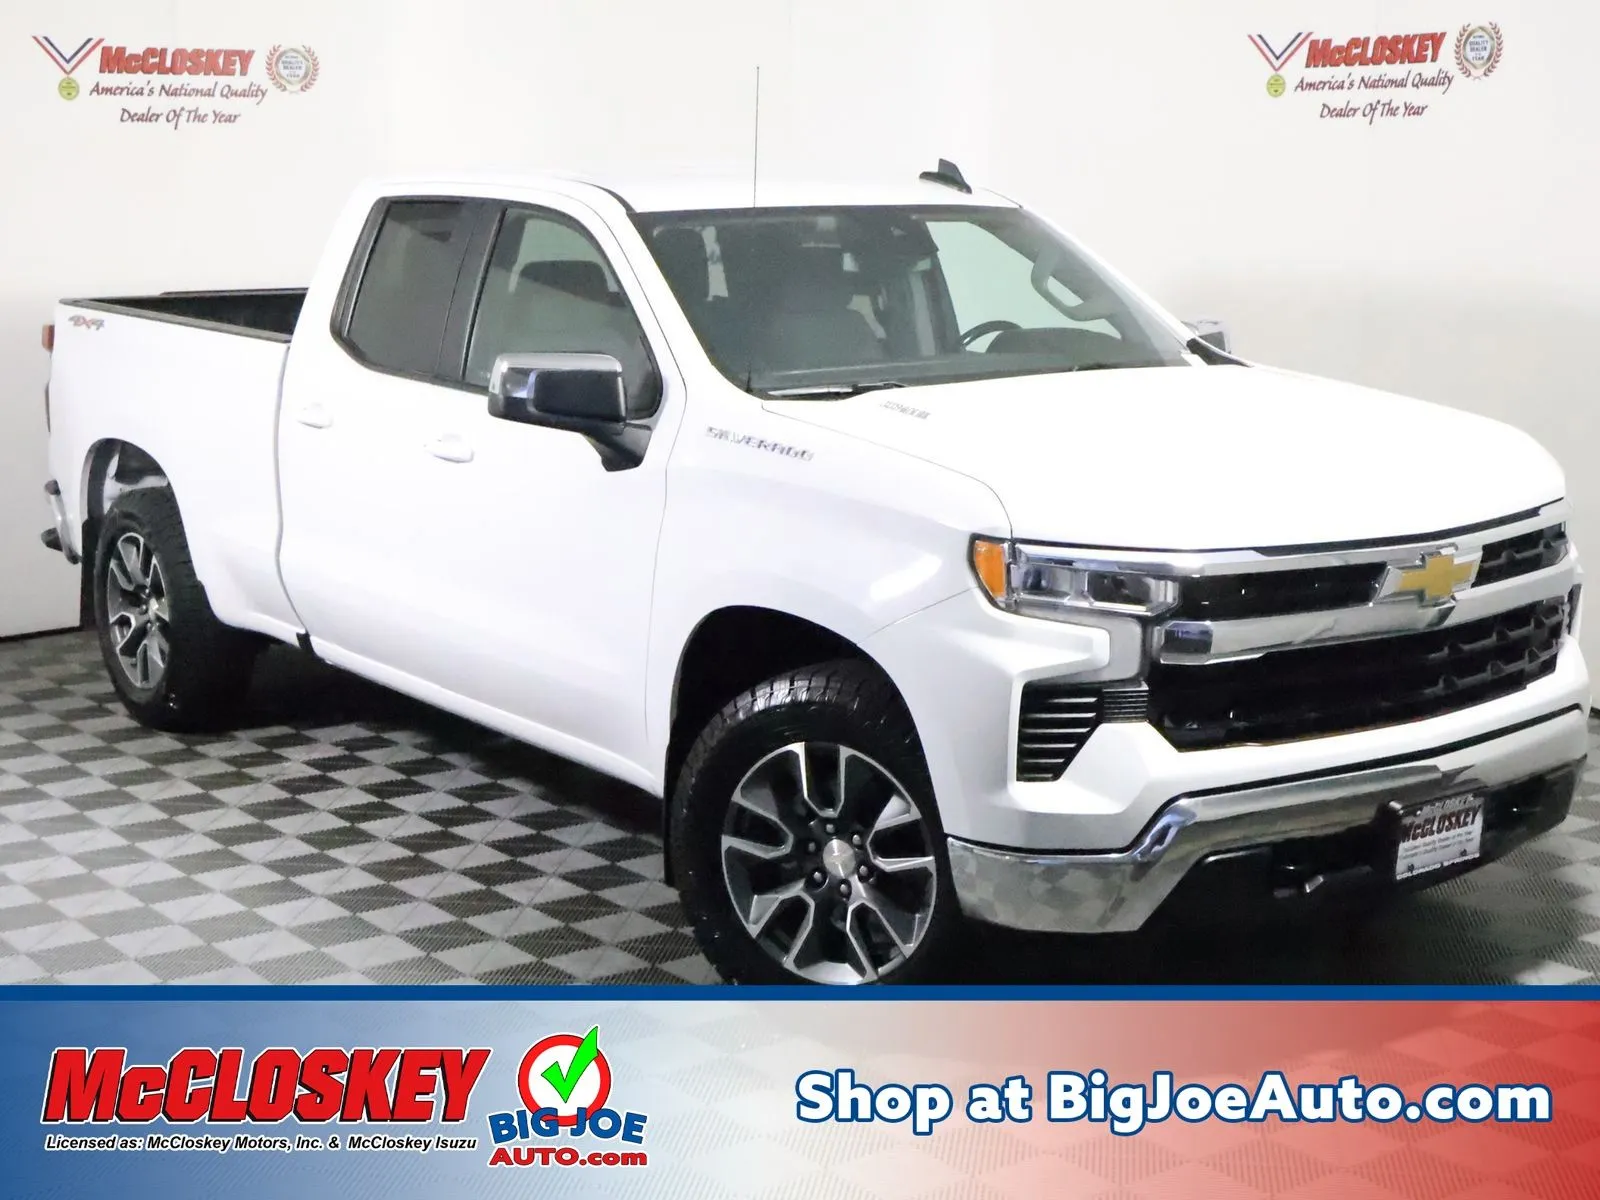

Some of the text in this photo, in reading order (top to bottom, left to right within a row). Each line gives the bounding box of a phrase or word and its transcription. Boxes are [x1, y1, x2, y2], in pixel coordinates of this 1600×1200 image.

[99, 46, 255, 76] McCLOSKEY
[1304, 32, 1447, 68] McCLOSKEY
[89, 80, 155, 96] America's
[158, 81, 219, 97] National
[220, 81, 268, 106] Quality
[1294, 72, 1354, 92] America's
[1357, 69, 1411, 90] National
[1411, 68, 1454, 95] Quality
[120, 105, 241, 131] Dealer Of The Year
[1319, 98, 1428, 125] Dealer Of The Year
